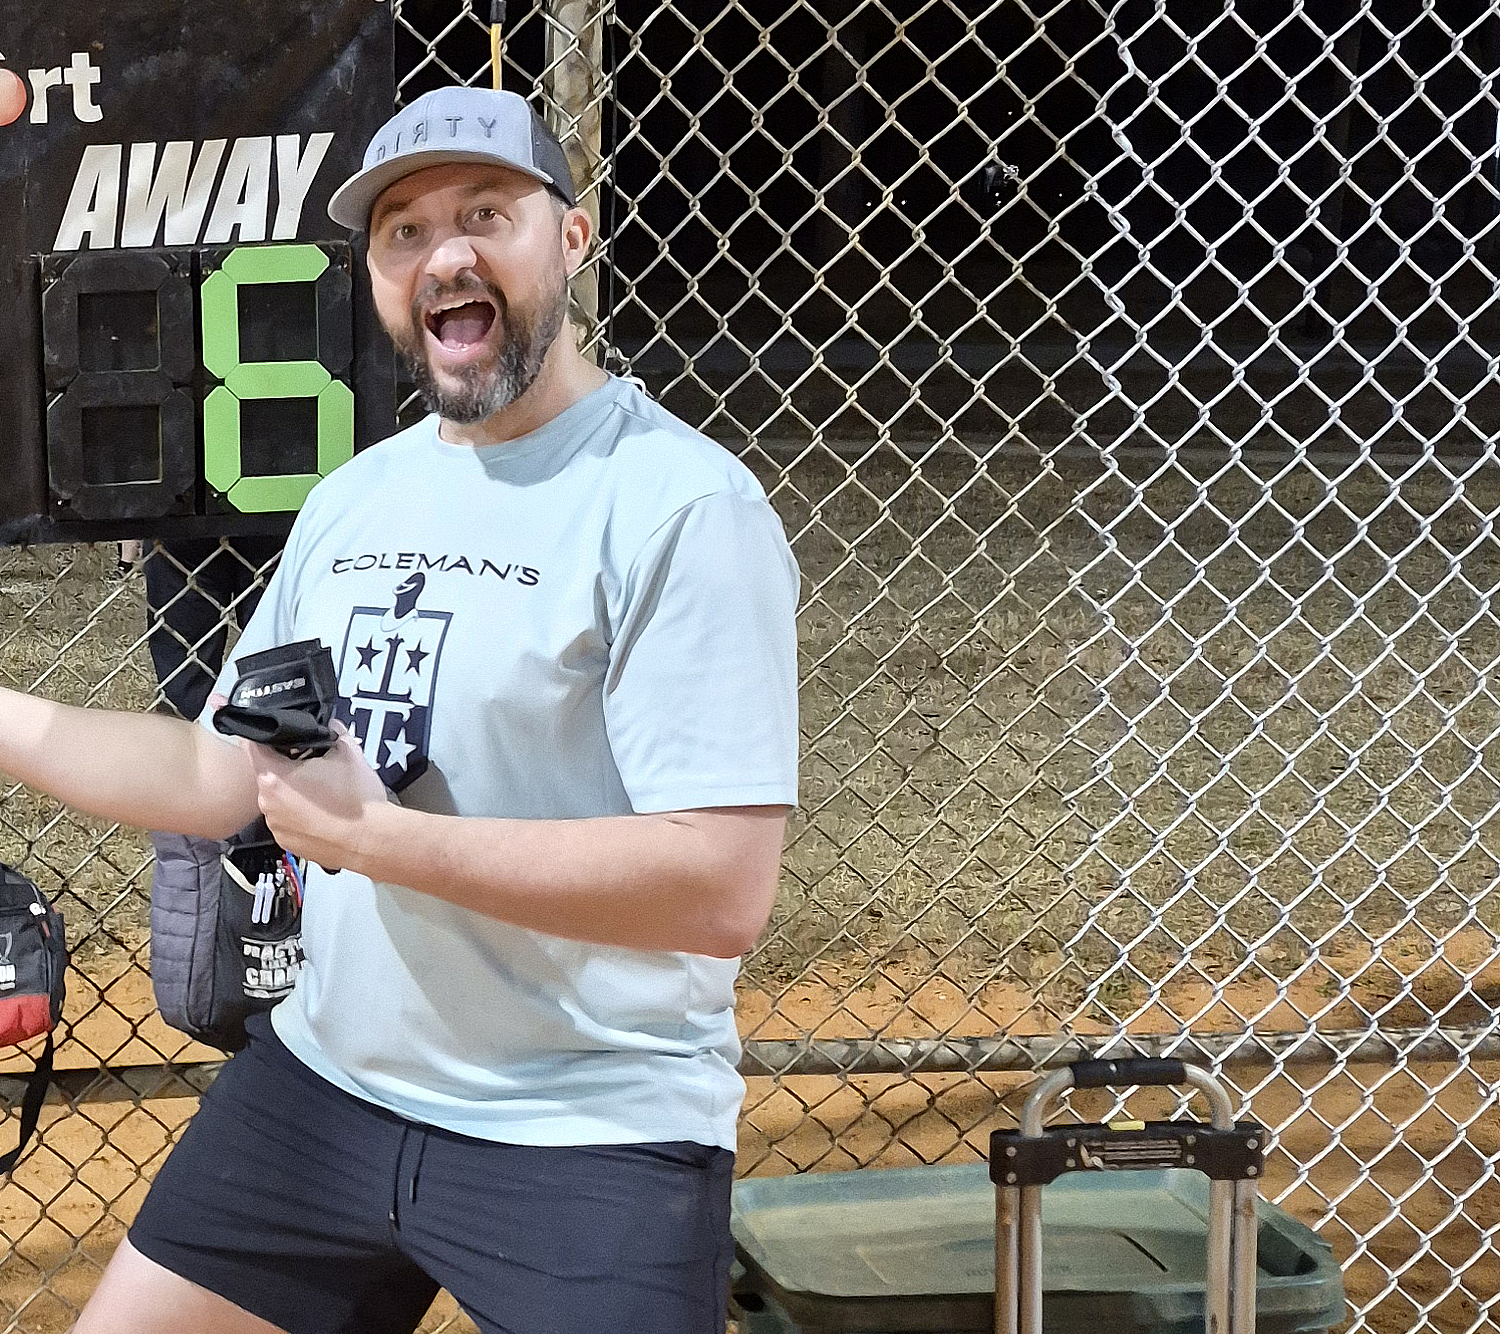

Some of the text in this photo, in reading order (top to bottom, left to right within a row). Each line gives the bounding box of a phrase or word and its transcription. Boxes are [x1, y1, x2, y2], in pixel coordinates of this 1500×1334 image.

[53, 132, 335, 252] AWAY
[201, 243, 355, 514] 6
[331, 552, 541, 586] COLEMAN'S
